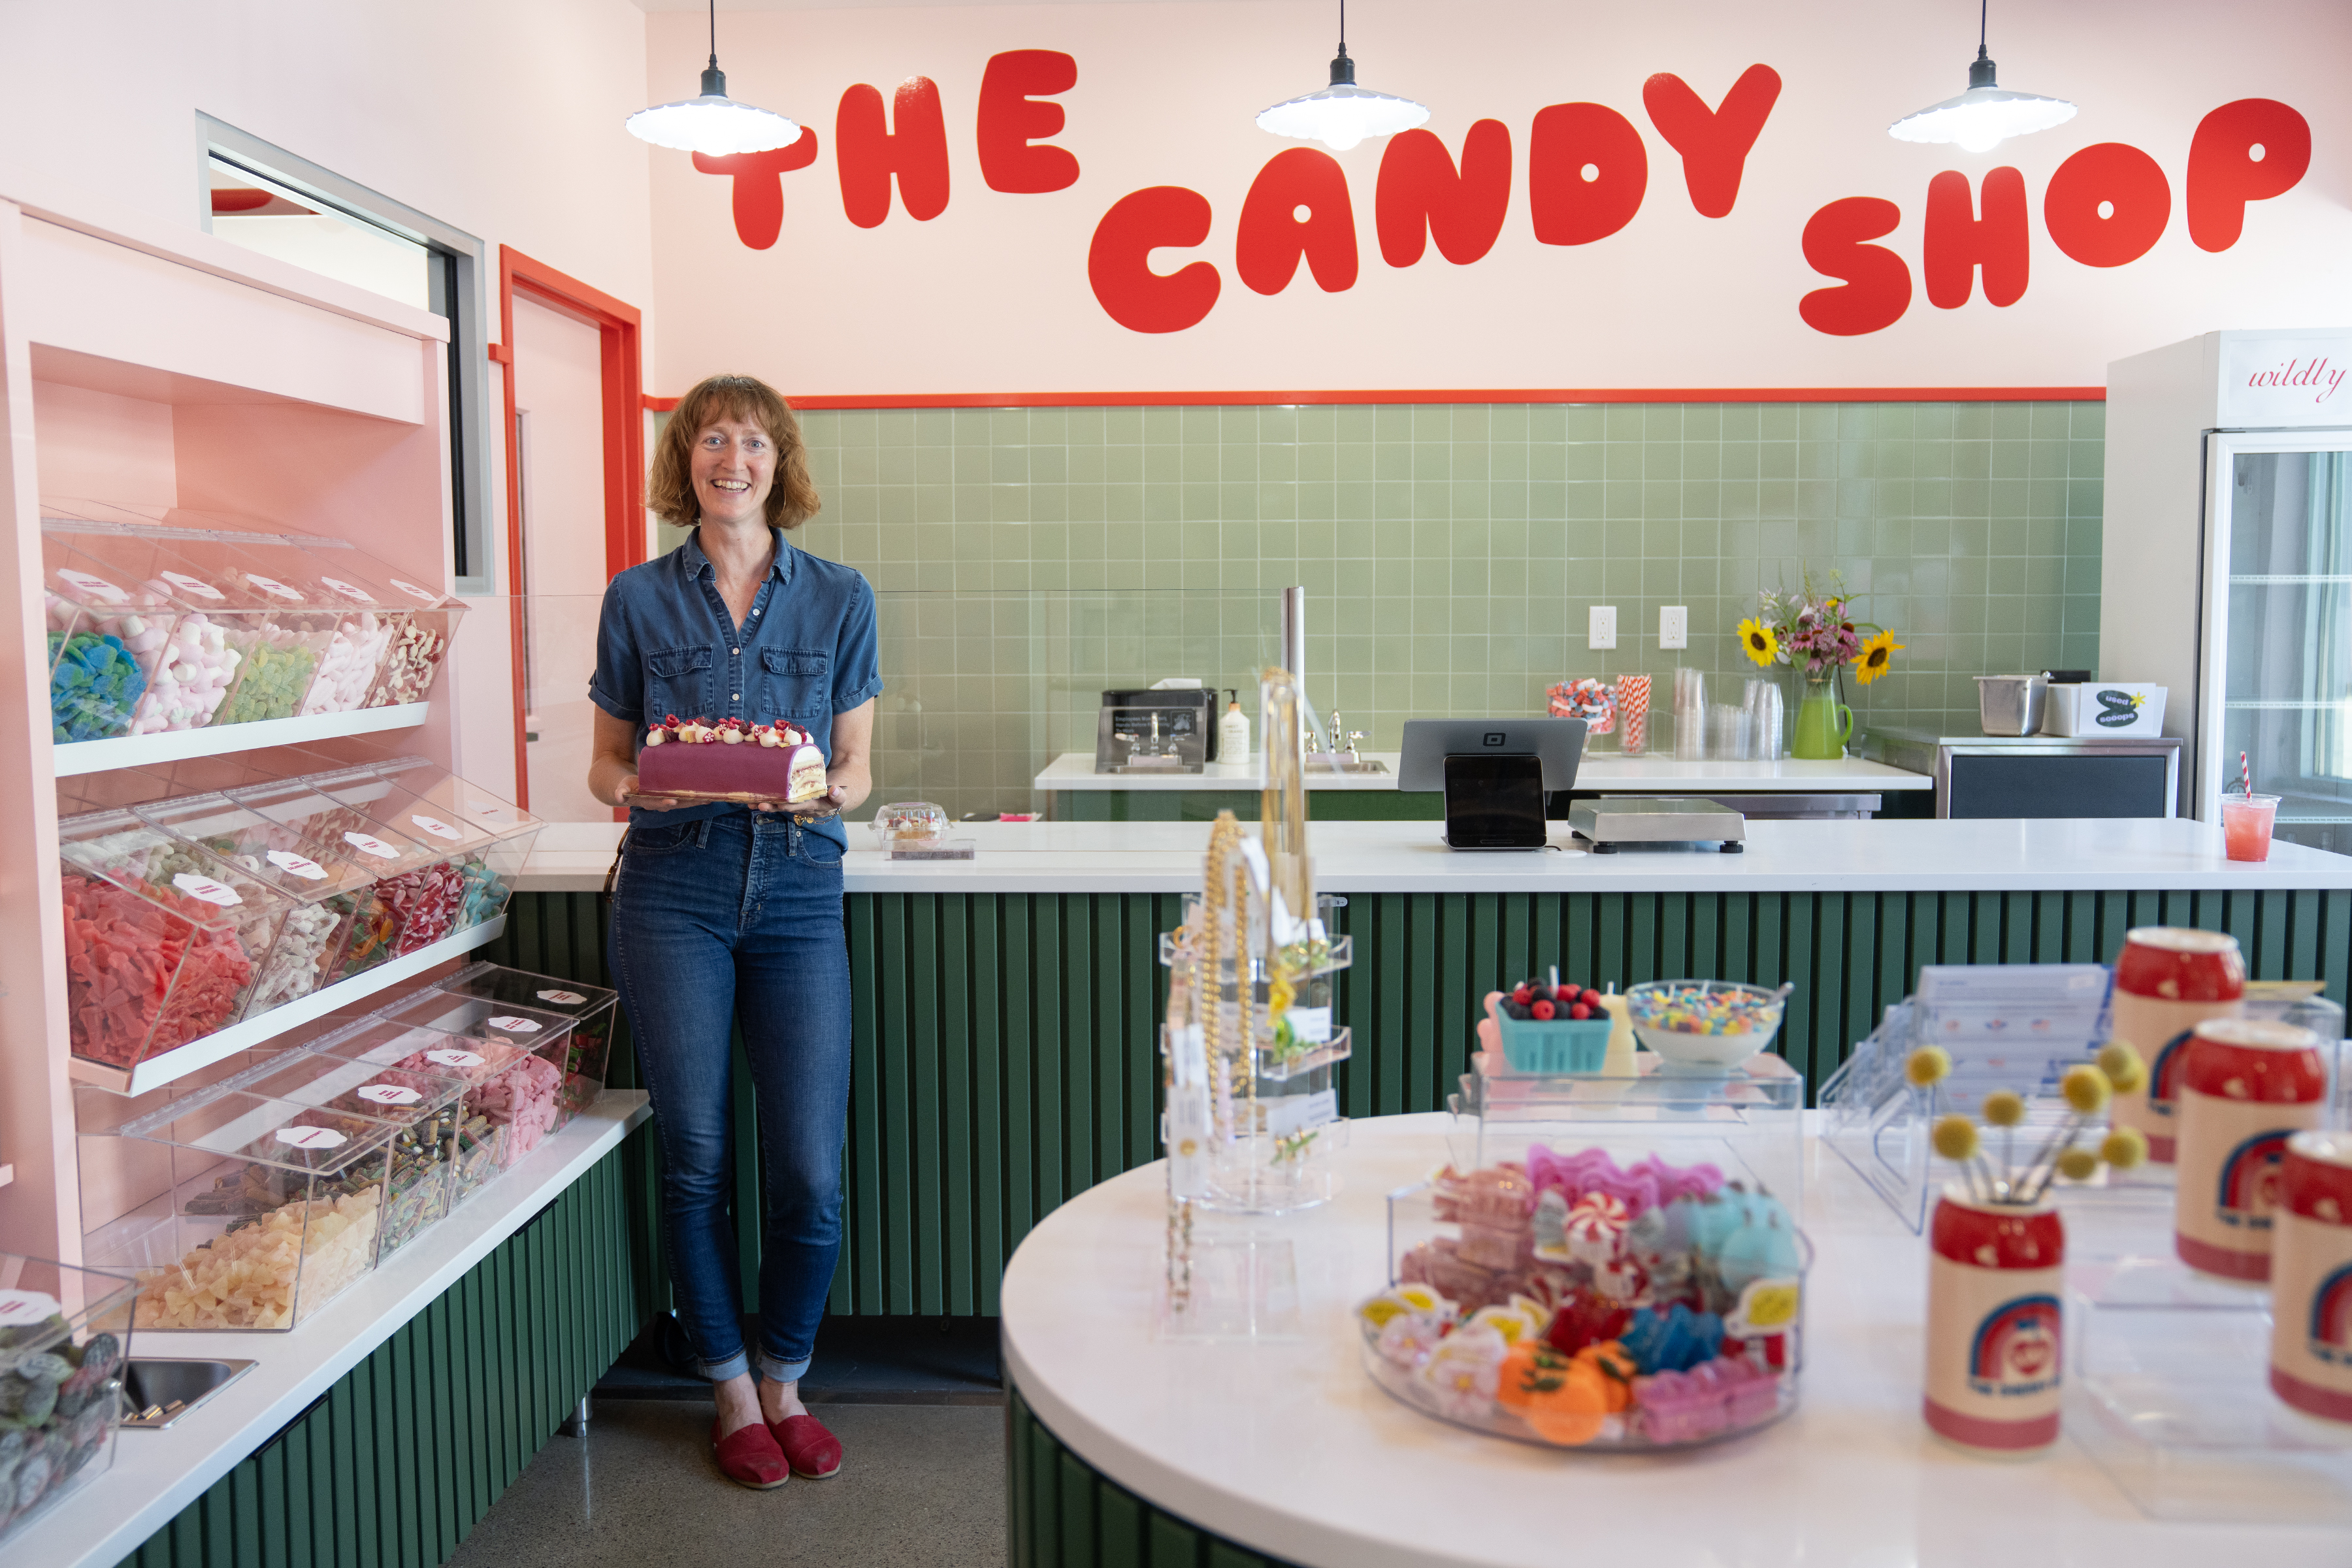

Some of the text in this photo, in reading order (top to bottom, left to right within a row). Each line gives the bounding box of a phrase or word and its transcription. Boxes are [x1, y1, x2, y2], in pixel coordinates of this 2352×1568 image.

[693, 50, 2311, 336] THE CANDY SHOP
[2249, 357, 2347, 403] wildly
[2106, 695, 2129, 706] used
[2100, 713, 2134, 723] scoops
[298, 1130, 323, 1143] GRAPEFRUIT
